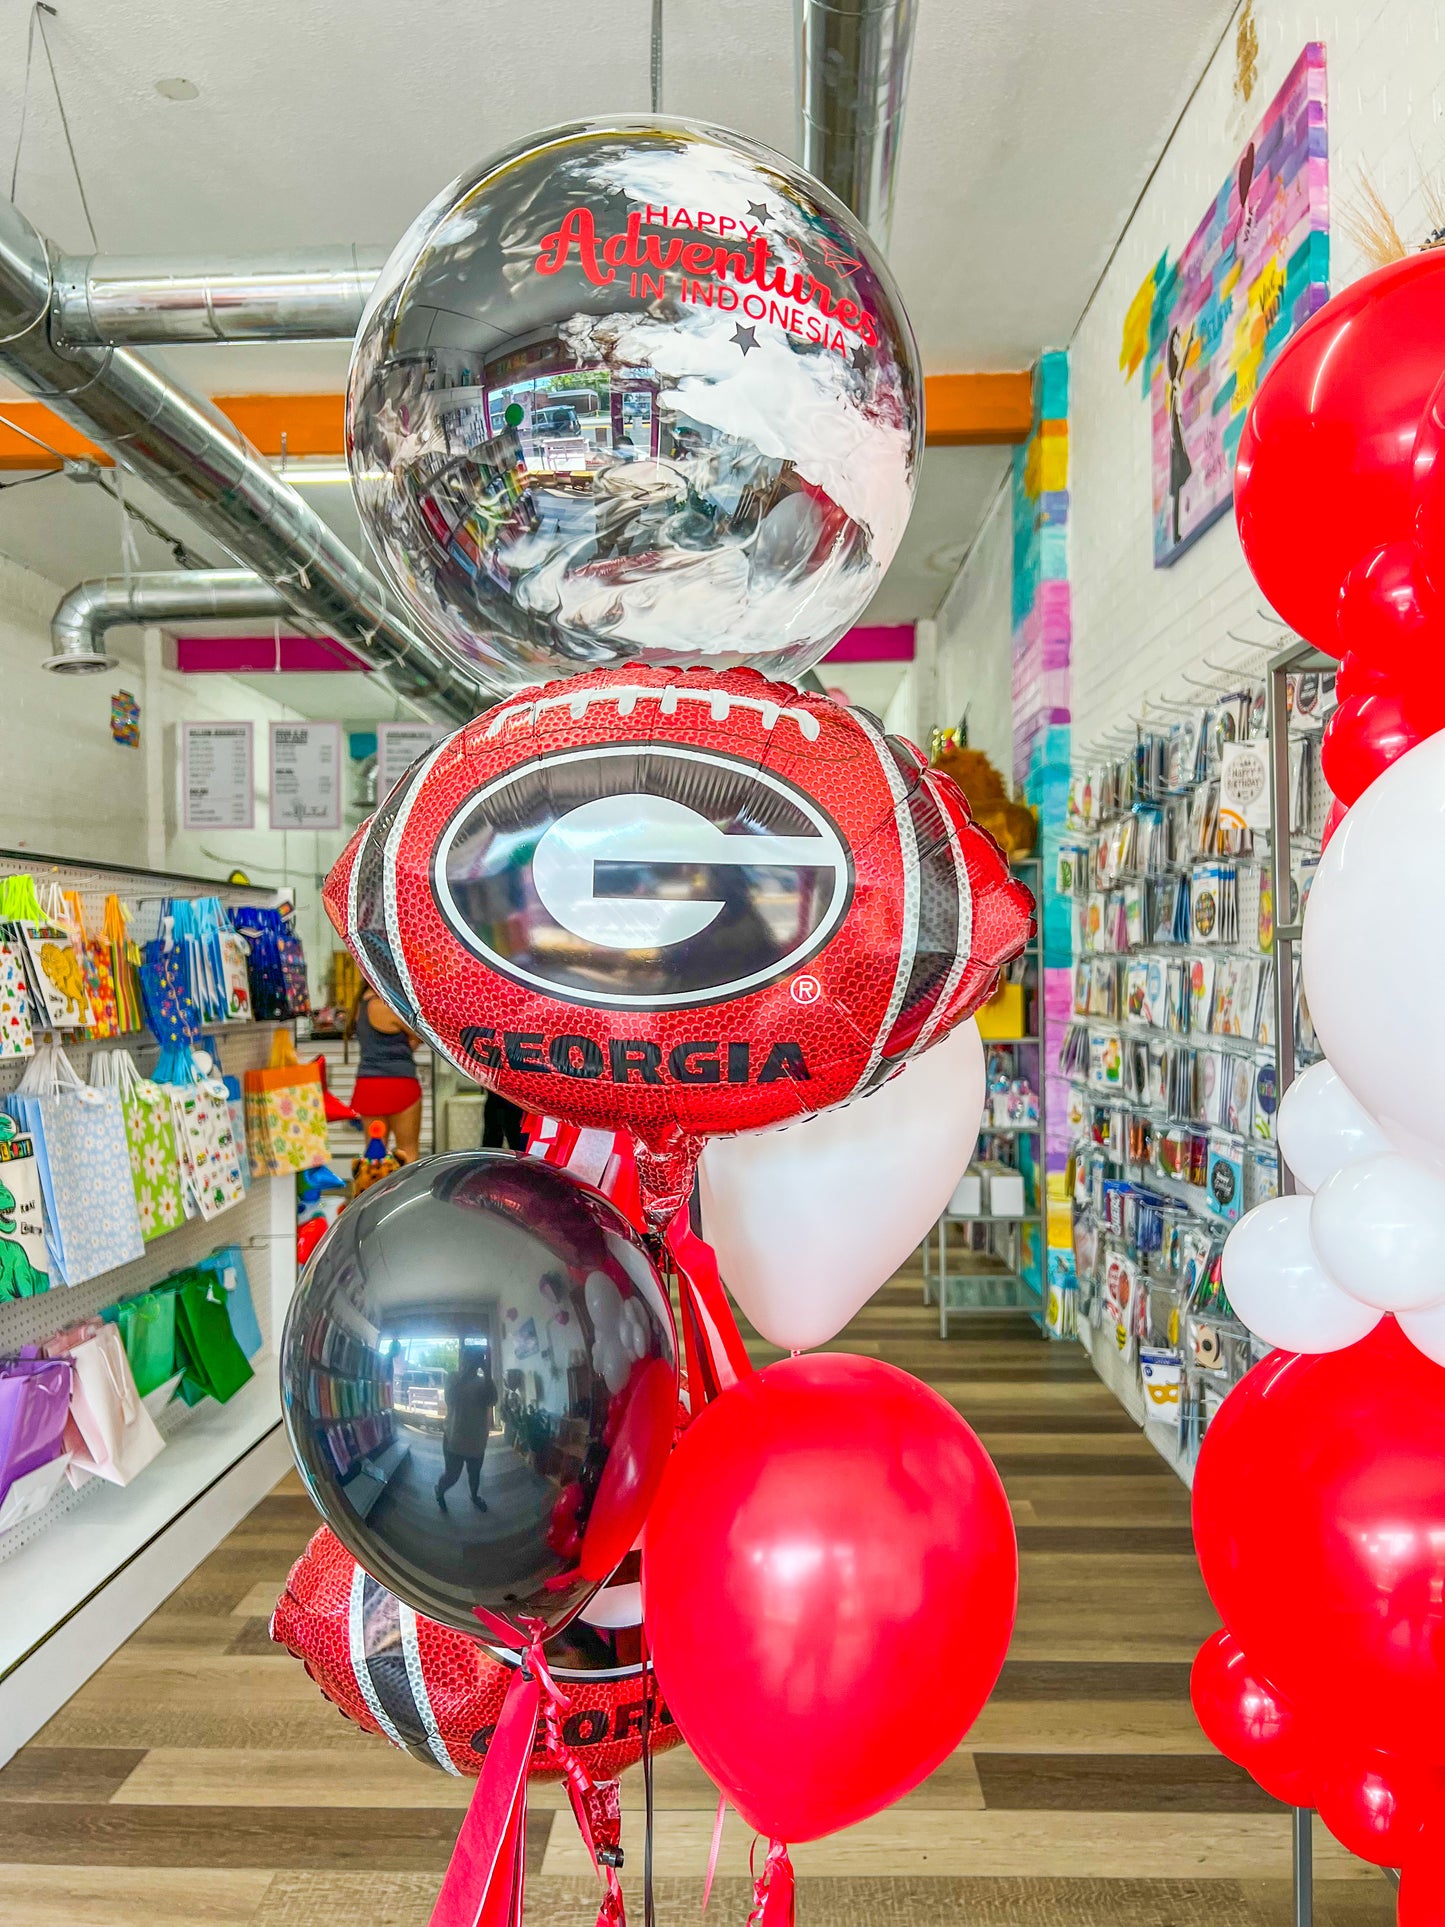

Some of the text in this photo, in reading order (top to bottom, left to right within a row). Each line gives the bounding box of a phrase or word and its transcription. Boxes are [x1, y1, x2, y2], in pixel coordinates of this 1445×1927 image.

[645, 203, 760, 243] HAPPY
[535, 207, 878, 348] Adventures
[630, 272, 848, 358] IN INDONESIA
[532, 793, 836, 949] G
[459, 1025, 812, 1084] GEORGIA
